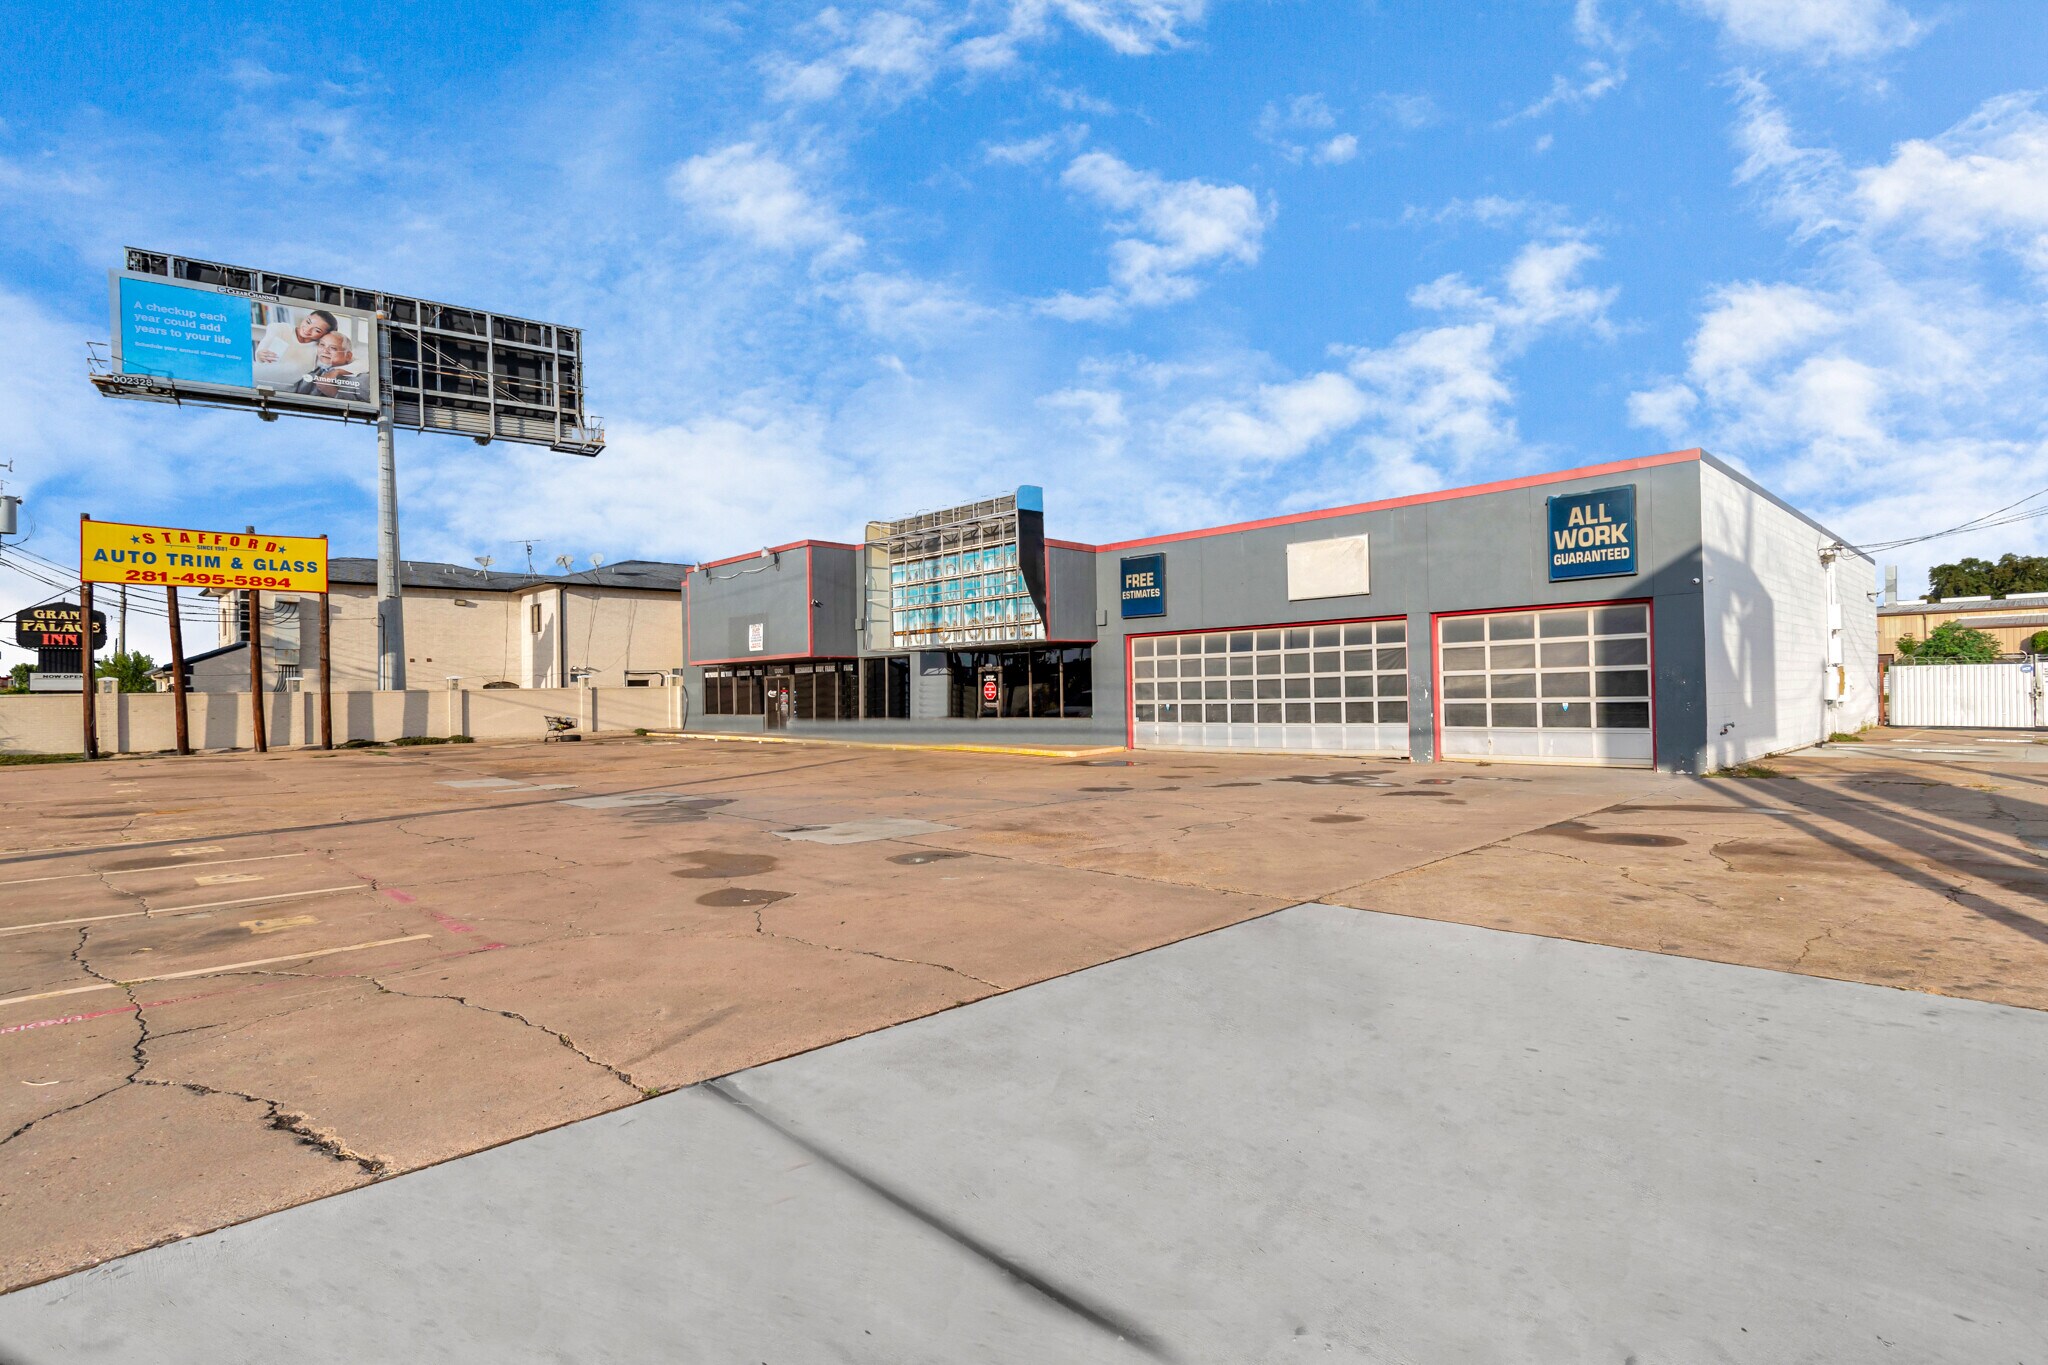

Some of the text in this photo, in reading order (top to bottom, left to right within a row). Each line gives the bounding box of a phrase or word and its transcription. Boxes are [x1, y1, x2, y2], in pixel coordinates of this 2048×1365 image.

[134, 301, 227, 322] A checkup each
[134, 313, 221, 332] year could add
[134, 324, 232, 345] years to your life
[112, 376, 153, 387] 002328
[313, 375, 360, 387] Amerigroup
[1568, 503, 1612, 527] ALL
[142, 532, 277, 552] STAFFORD
[1554, 523, 1628, 550] WORK
[93, 548, 318, 573] AUTO TRIM & GLASS
[1554, 547, 1630, 566] GUARANTEED
[125, 569, 291, 588] 281-495-5894
[1125, 572, 1154, 588] FREE
[1122, 588, 1160, 600] ESTIMATES
[33, 609, 81, 619] GRAN
[42, 633, 78, 645] INN
